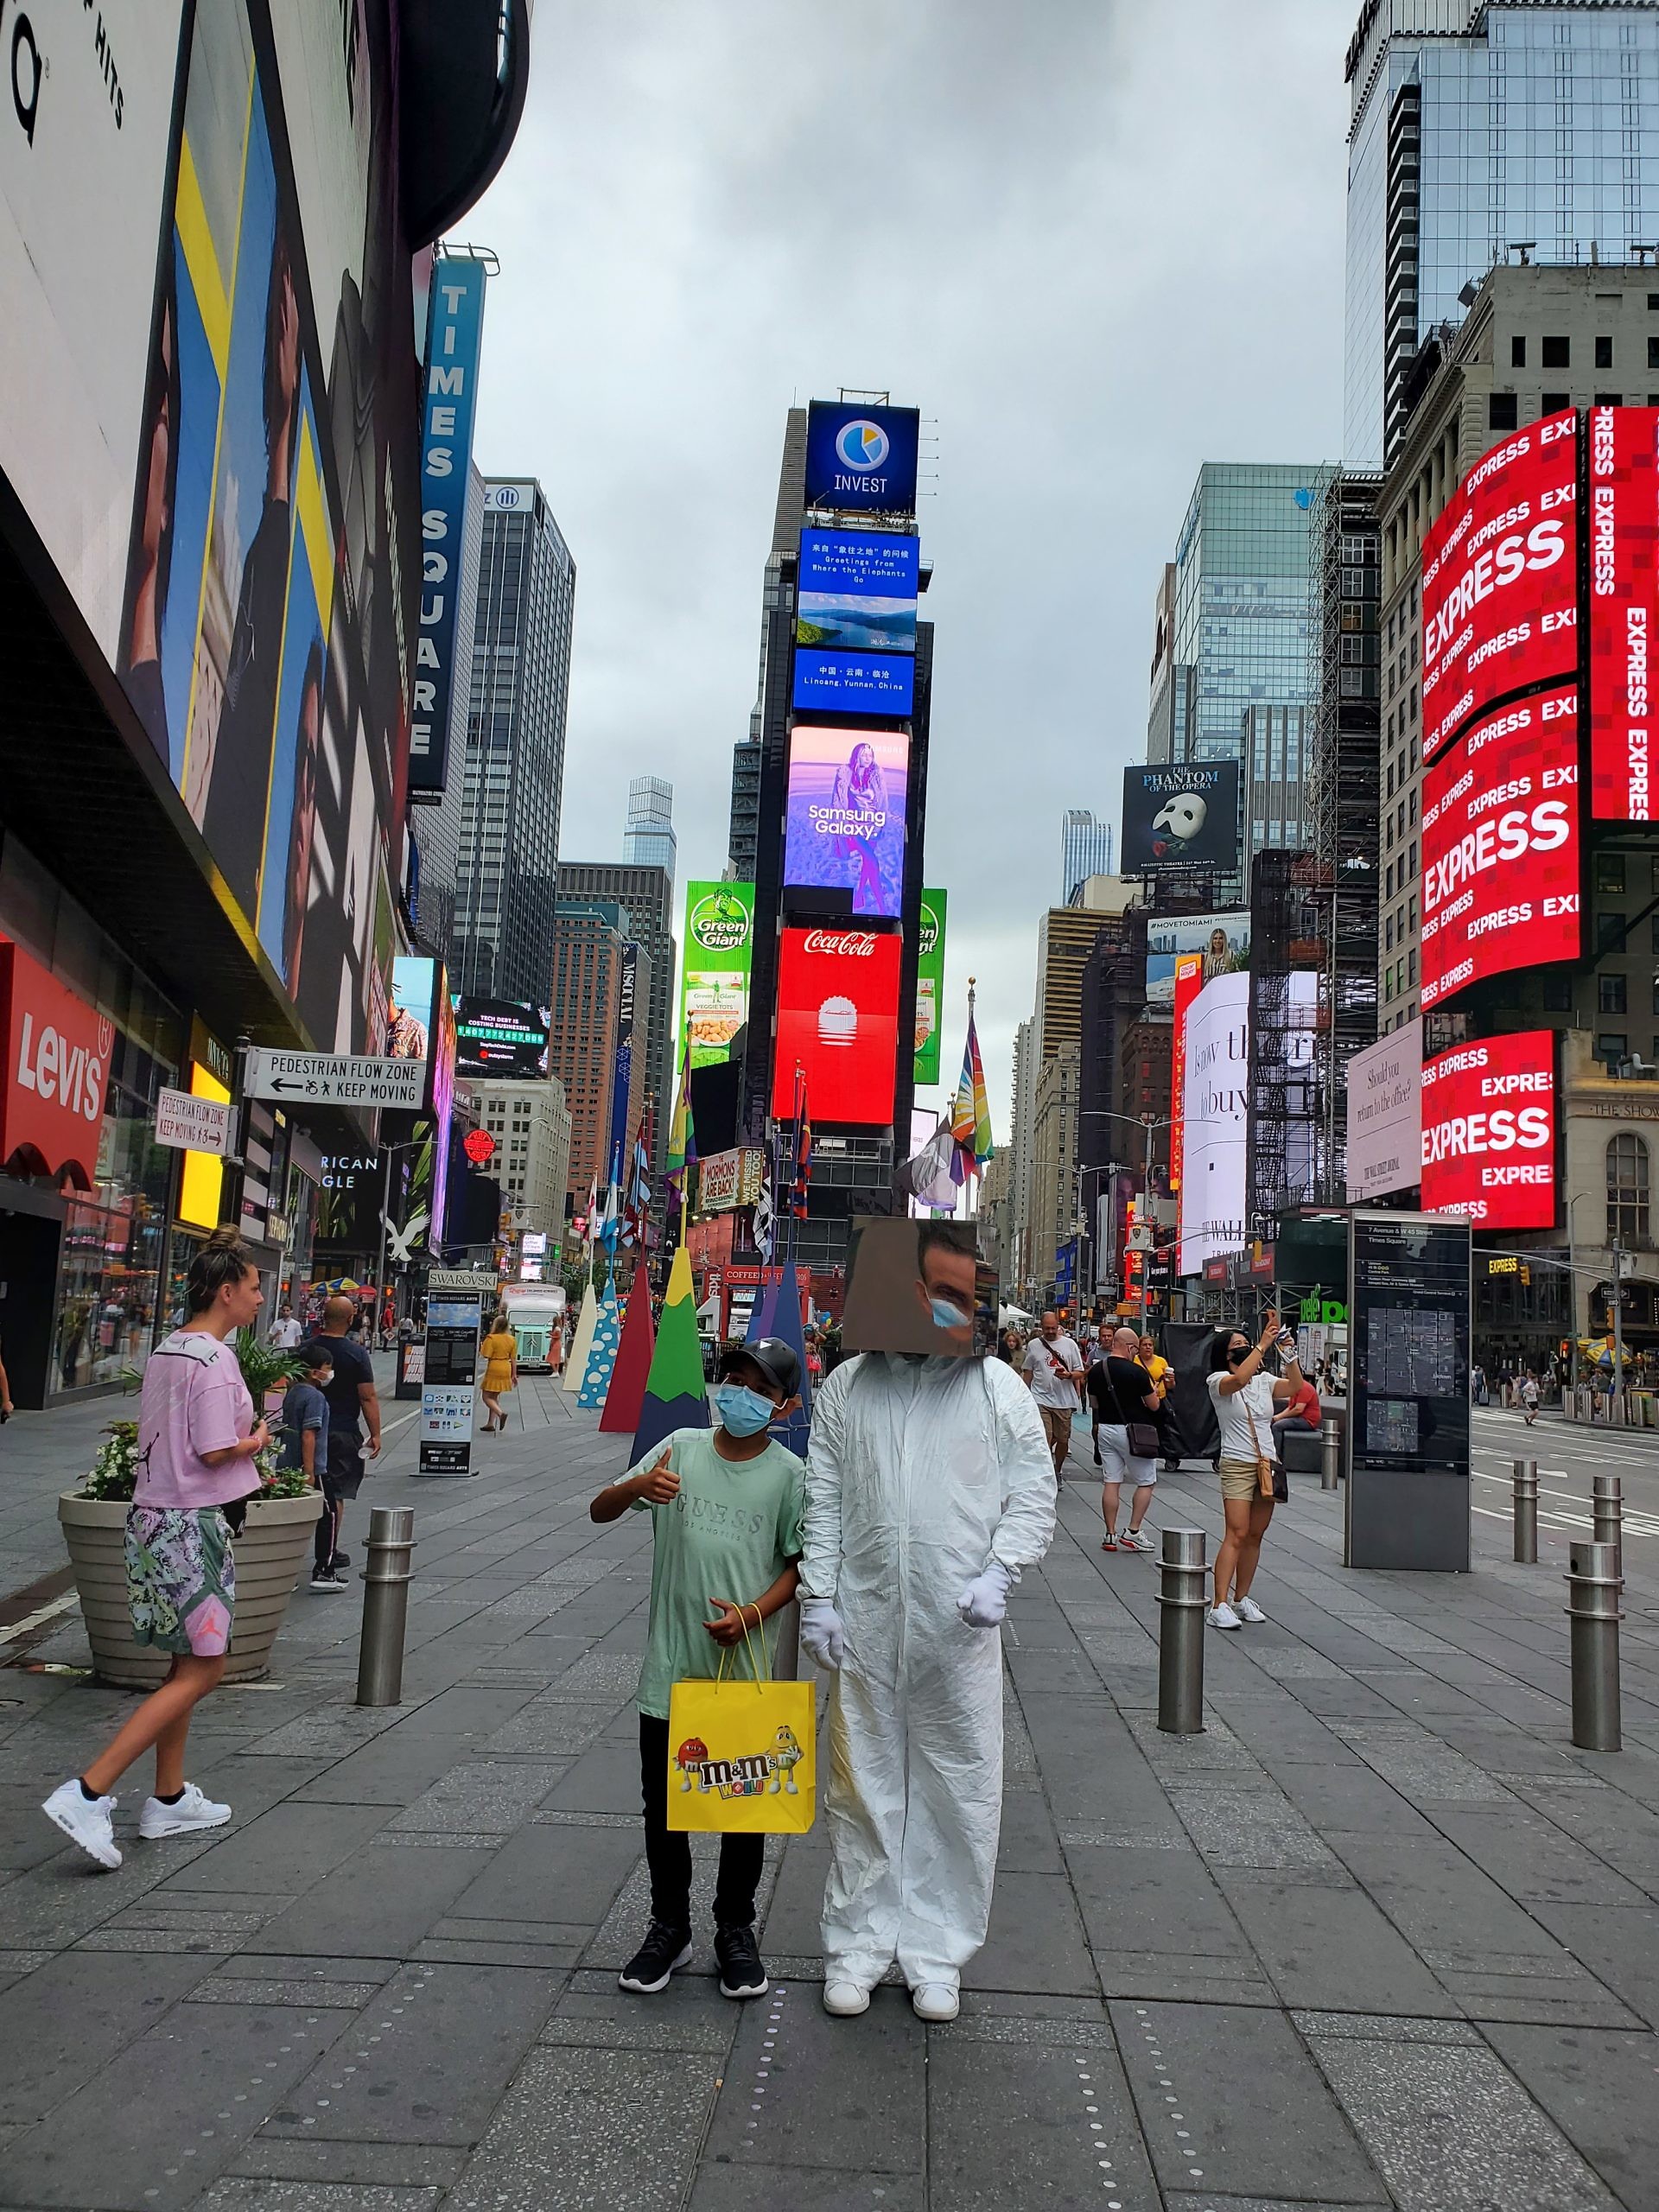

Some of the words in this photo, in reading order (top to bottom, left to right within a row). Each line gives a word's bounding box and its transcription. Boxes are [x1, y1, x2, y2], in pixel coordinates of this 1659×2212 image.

[425, 285, 467, 477] TIMES
[1467, 436, 1530, 497] EXPRESS
[833, 474, 888, 494] INVEST
[1441, 508, 1473, 564] EXPRESS
[1467, 501, 1530, 558] EXPRESS
[1594, 486, 1616, 596] EXPRESS
[812, 563, 837, 573] Where
[861, 568, 906, 578] Elephants
[825, 556, 869, 566] Greetings
[874, 559, 894, 568] from
[854, 575, 865, 584] Go
[1425, 518, 1566, 668] EXPRESS
[409, 508, 448, 755] SQUARE
[1441, 623, 1474, 675] EXPRESS
[1467, 622, 1531, 674] EXPRESS
[1626, 607, 1648, 719] EXPRESS
[1441, 689, 1474, 737] EXPRESS
[1467, 709, 1531, 757] EXPRESS
[1142, 771, 1219, 787] PHANTOM
[1149, 785, 1162, 793] OF
[1164, 783, 1181, 791] THE
[1181, 782, 1211, 791] OPERA
[1441, 769, 1474, 814] EXPRESS
[1467, 776, 1532, 821] EXPRESS
[808, 804, 886, 826] Samsung
[1425, 801, 1570, 913] EXPRESS
[1440, 890, 1474, 929] EXPRESS
[1467, 902, 1533, 941] EXPRESS
[697, 918, 746, 934] Green
[1150, 918, 1213, 930] #MOVETOMIAMI
[702, 931, 747, 948] Giant
[804, 929, 879, 957] Coca-Cola
[1440, 957, 1474, 994] EXPRESS
[467, 1020, 494, 1028] COSTING
[494, 1022, 531, 1032] BUSINESSES
[270, 1057, 346, 1077] PEDESTRIAN
[351, 1062, 382, 1078] FLOW
[385, 1065, 417, 1081] ZONE
[1367, 1061, 1388, 1091] Should
[1439, 1048, 1488, 1079] EXPRESS
[336, 1082, 365, 1098] KEEP
[370, 1084, 416, 1102] MOVING
[162, 1096, 195, 1118] PEDESTRIAN
[196, 1103, 210, 1121] FLOW
[210, 1108, 225, 1125] ZONE
[1357, 1101, 1375, 1123] return
[1593, 1103, 1619, 1116] THE
[159, 1118, 174, 1137] KEEP
[175, 1122, 196, 1139] MOVING
[1421, 1107, 1550, 1166] EXPRESS
[706, 1160, 734, 1183] MORMONS
[743, 1150, 752, 1184] MISSED
[1481, 1165, 1552, 1186] EXPRE
[319, 1175, 355, 1189] GLE
[705, 1181, 717, 1198] ARE
[717, 1177, 734, 1196] BACK!
[743, 1185, 751, 1202] WE
[750, 1178, 760, 1202] YOU
[1489, 1257, 1517, 1274] EXPRESS
[429, 1273, 497, 1287] SWAROVSKI
[708, 1272, 721, 1297] tkts
[676, 1492, 764, 1535] GUESS
[721, 1779, 764, 1798] WORLD
